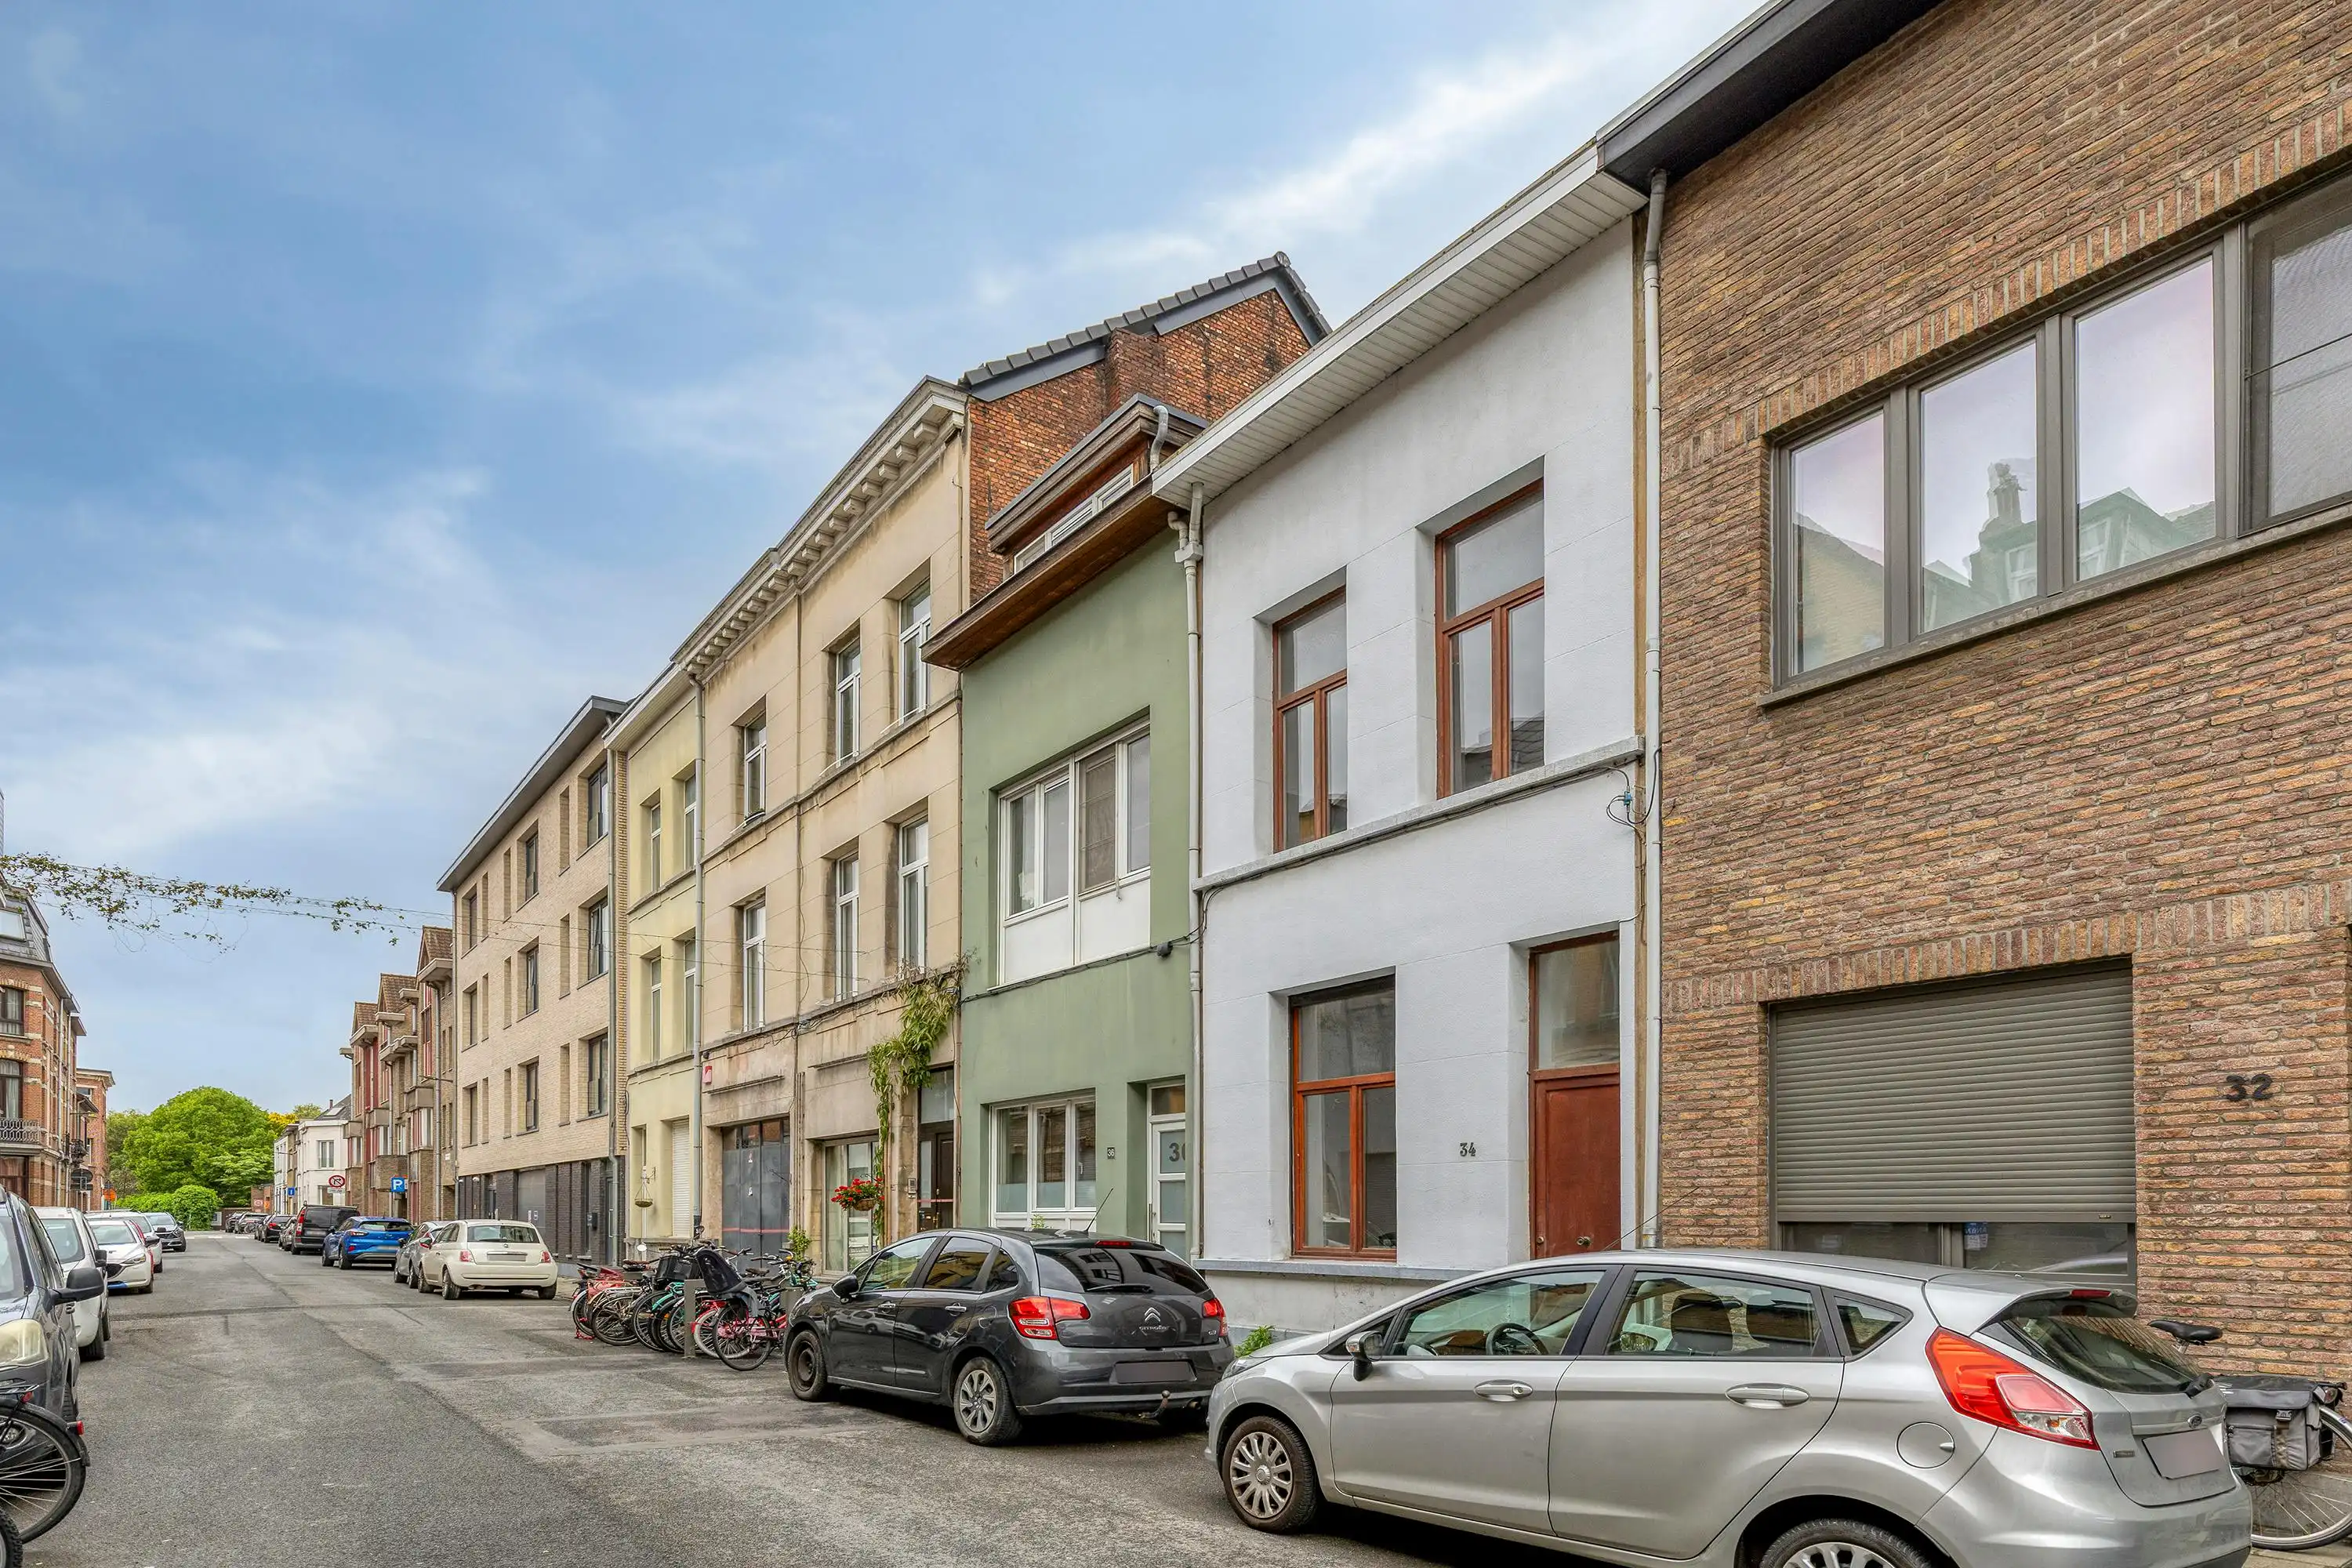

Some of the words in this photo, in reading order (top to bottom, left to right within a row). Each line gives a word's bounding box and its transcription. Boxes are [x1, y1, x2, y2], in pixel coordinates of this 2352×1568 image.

[2225, 1073, 2273, 1102] 32
[1460, 1142, 1476, 1157] 34
[393, 1179, 403, 1190] P
